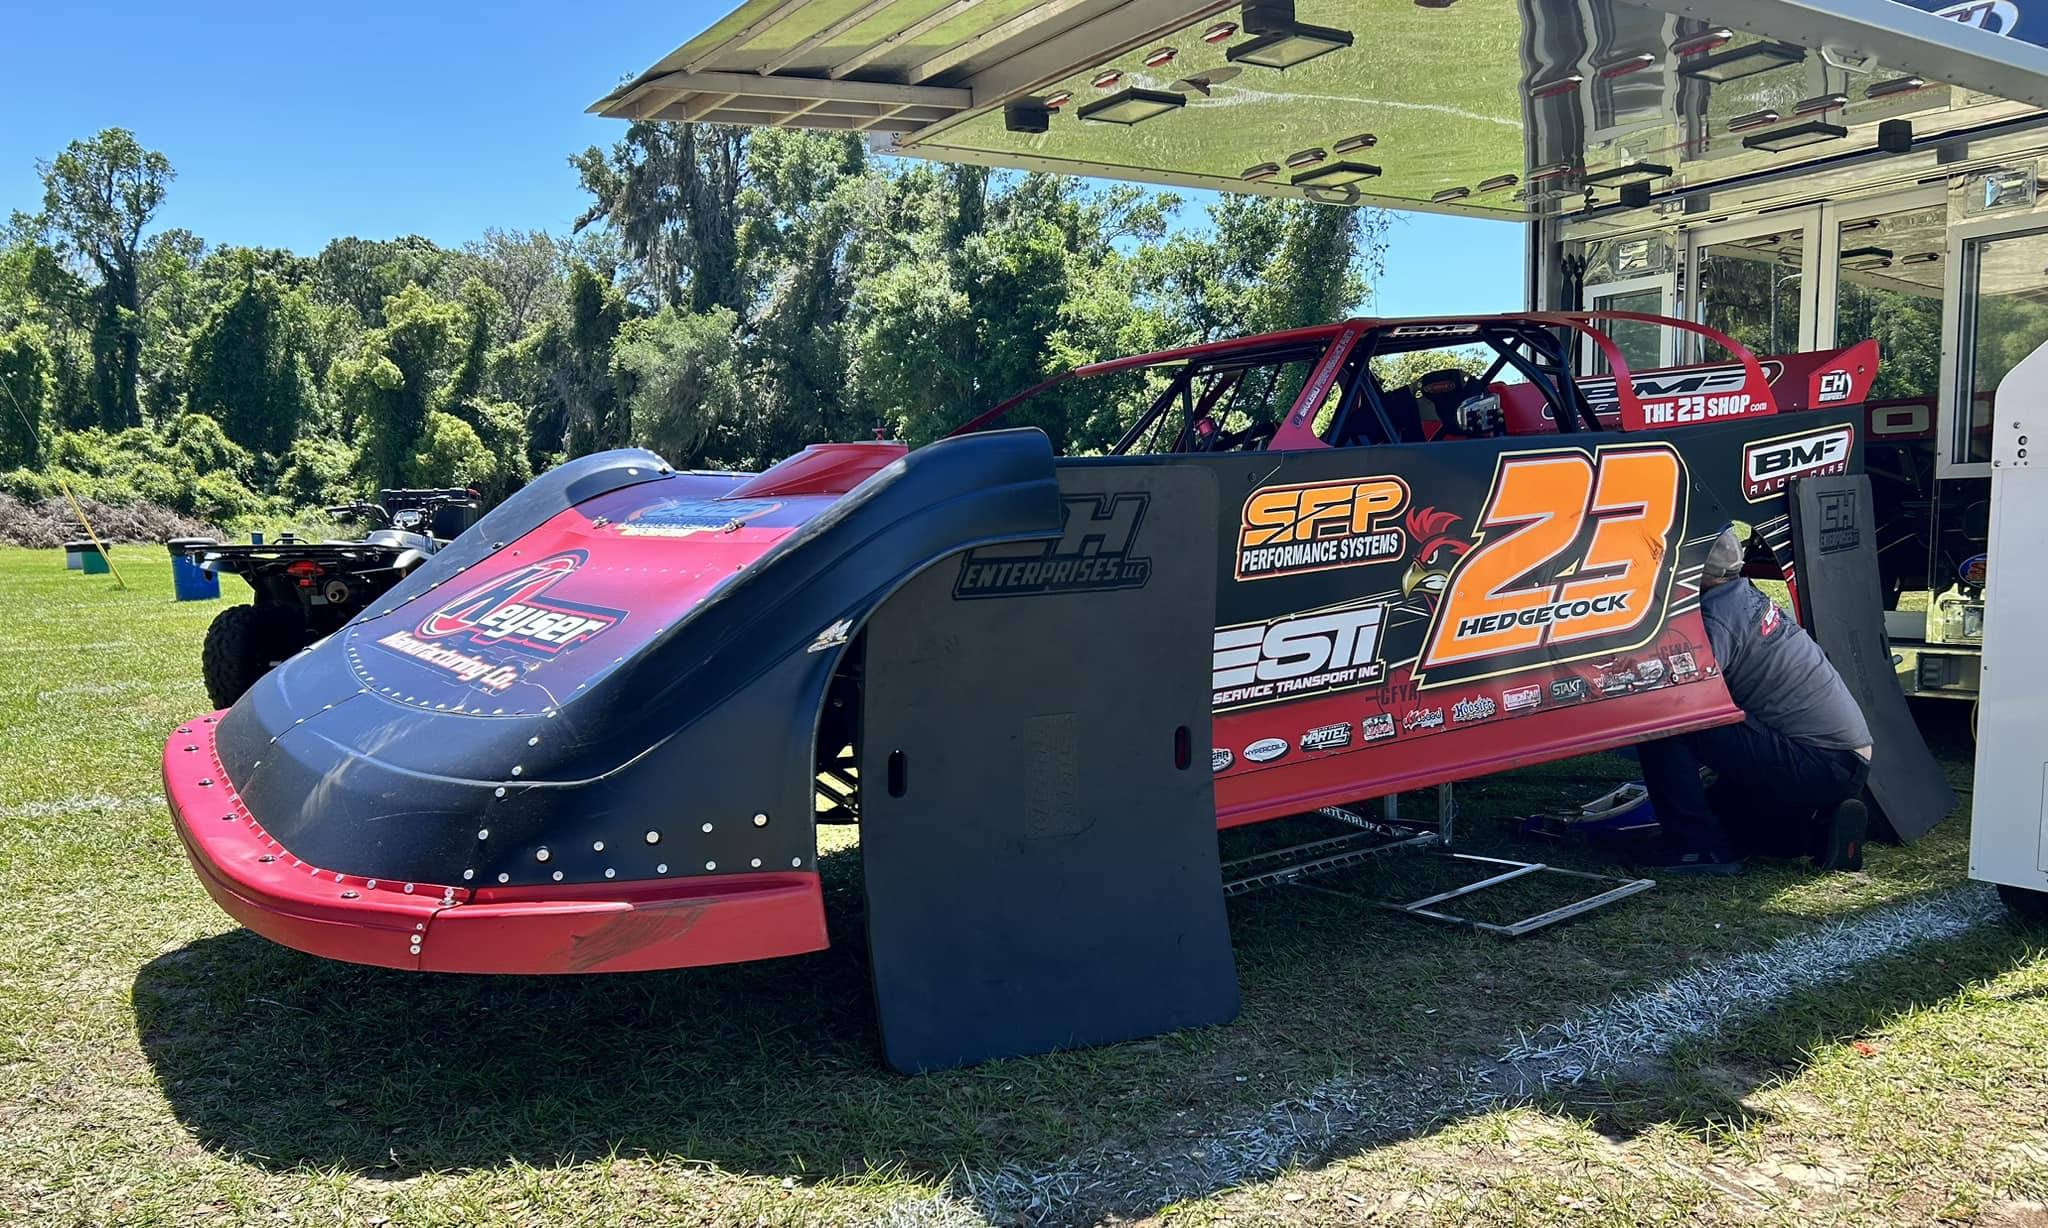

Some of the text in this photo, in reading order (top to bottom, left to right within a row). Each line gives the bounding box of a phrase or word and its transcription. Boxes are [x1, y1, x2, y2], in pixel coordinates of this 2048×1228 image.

[1643, 403, 1674, 424] THE
[1678, 397, 1704, 422] 23
[1707, 394, 1750, 416] SHOP
[1754, 437, 1846, 476] BMF
[1243, 482, 1402, 546] SFP
[1241, 533, 1398, 572] PERFORMANCE SYSTEMS
[1425, 452, 1679, 665] 23
[438, 566, 608, 644] Keyser
[1457, 593, 1629, 637] HEDGECOCK
[377, 632, 518, 690] Manufacturing Co.
[1212, 664, 1380, 705] SERVICE TRANSPORT INC
[1246, 742, 1286, 756] HYPERCOILS
[1301, 726, 1347, 746] MARTEL
